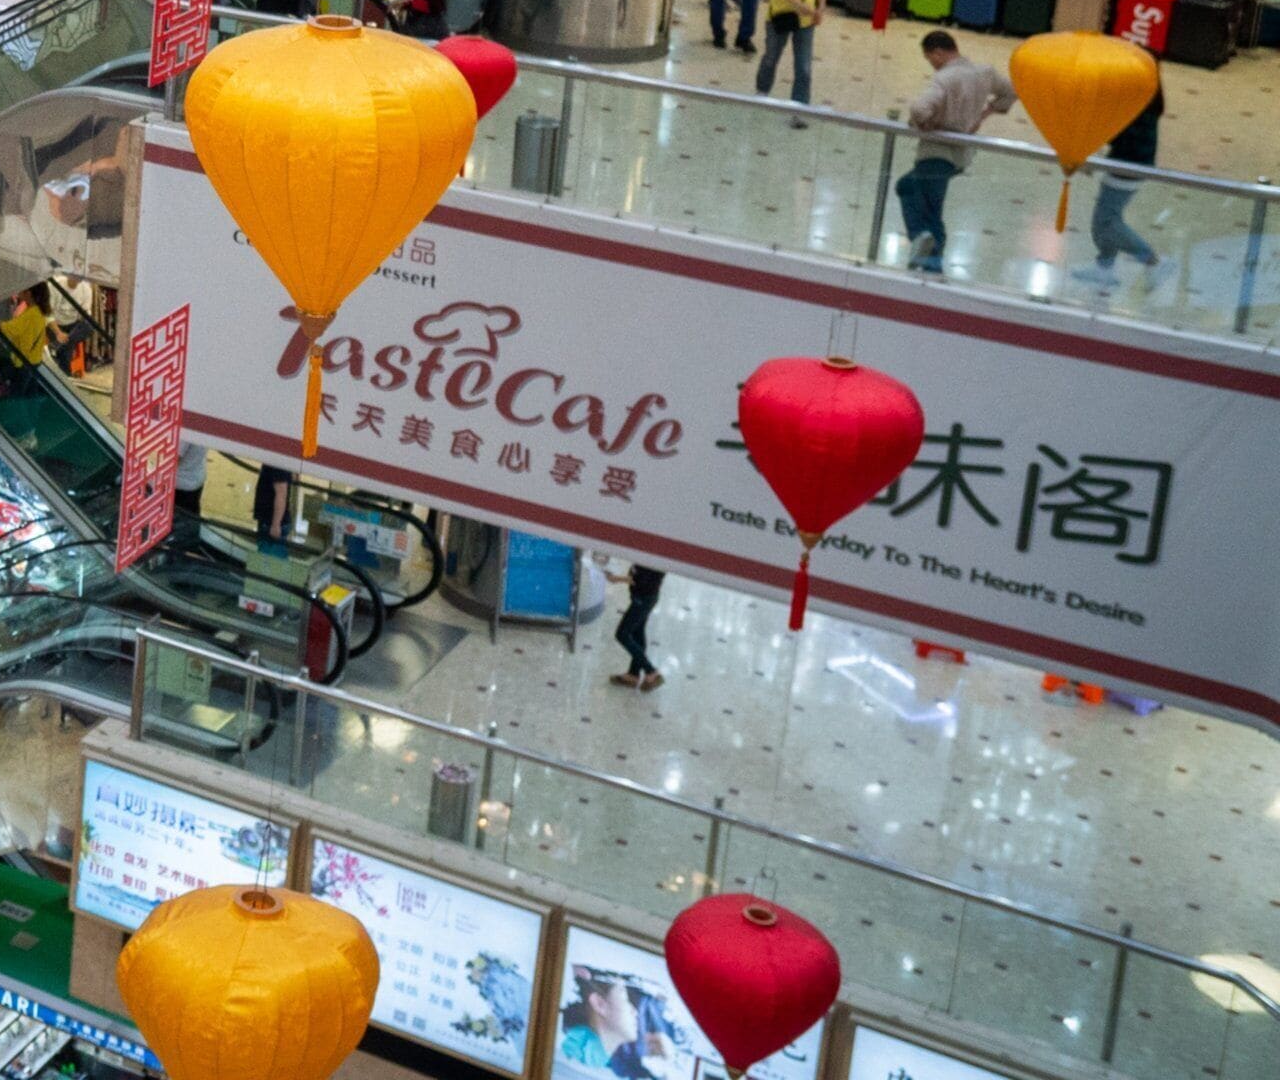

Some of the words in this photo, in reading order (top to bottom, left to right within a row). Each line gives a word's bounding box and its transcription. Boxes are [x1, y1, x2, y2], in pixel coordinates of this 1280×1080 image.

[392, 238, 436, 266] 品
[709, 502, 767, 531] Taste
[774, 515, 876, 560] Evyday
[882, 544, 912, 568] To
[919, 553, 961, 581] The
[970, 566, 1056, 605] Heart's
[1065, 591, 1146, 627] Desire
